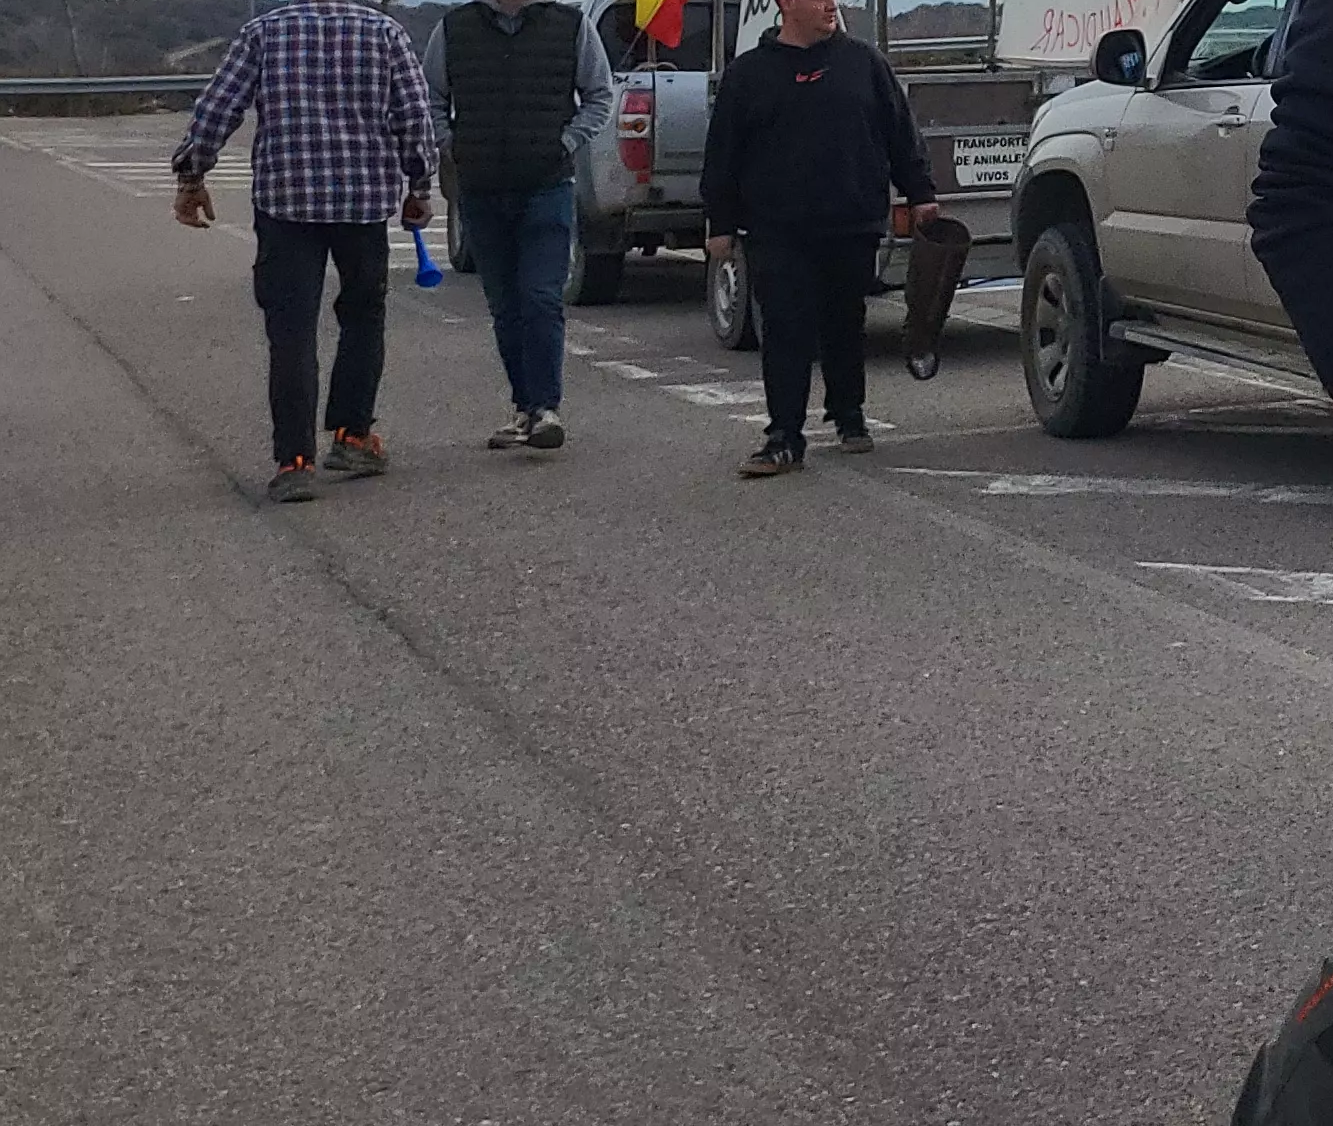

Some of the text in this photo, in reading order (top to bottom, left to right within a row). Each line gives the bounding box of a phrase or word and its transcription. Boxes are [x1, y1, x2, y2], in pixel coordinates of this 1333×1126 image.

[957, 137, 1028, 148] TRANSPORTE
[957, 156, 970, 165] DE
[976, 171, 1009, 181] VIVOS
